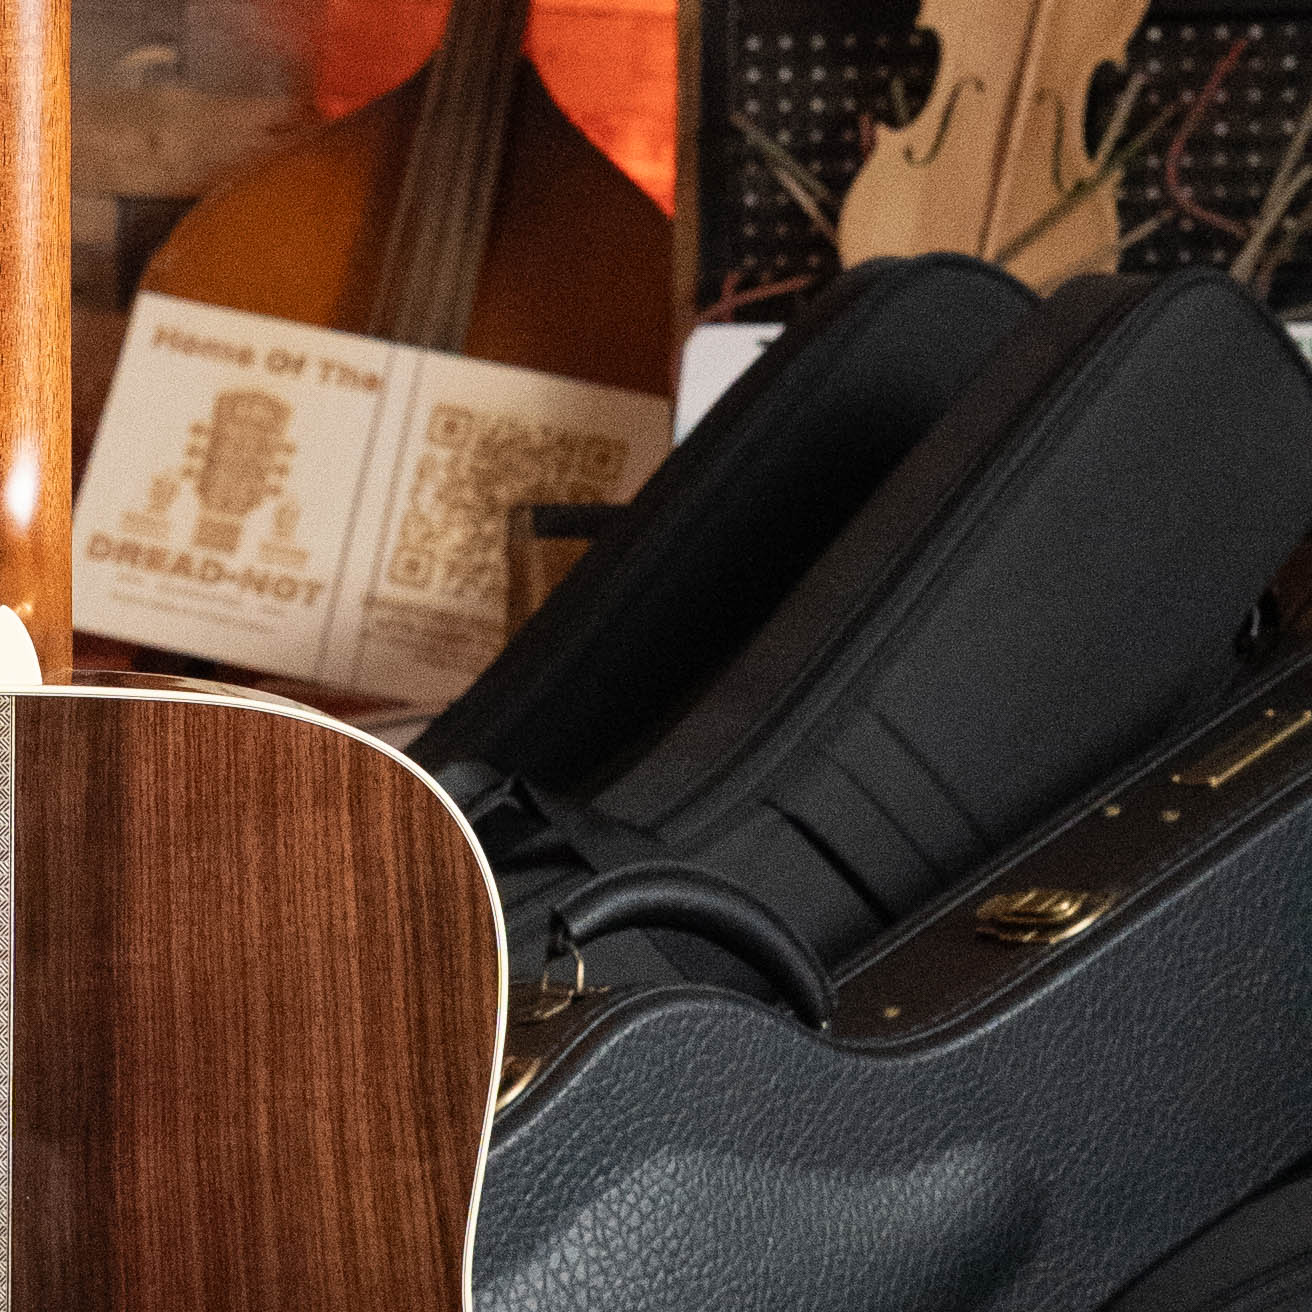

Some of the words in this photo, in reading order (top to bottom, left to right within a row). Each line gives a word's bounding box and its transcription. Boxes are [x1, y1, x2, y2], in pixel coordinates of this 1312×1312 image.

[152, 324, 256, 370] Home
[265, 345, 305, 376] Of
[86, 532, 328, 608] DREAD-NOT
